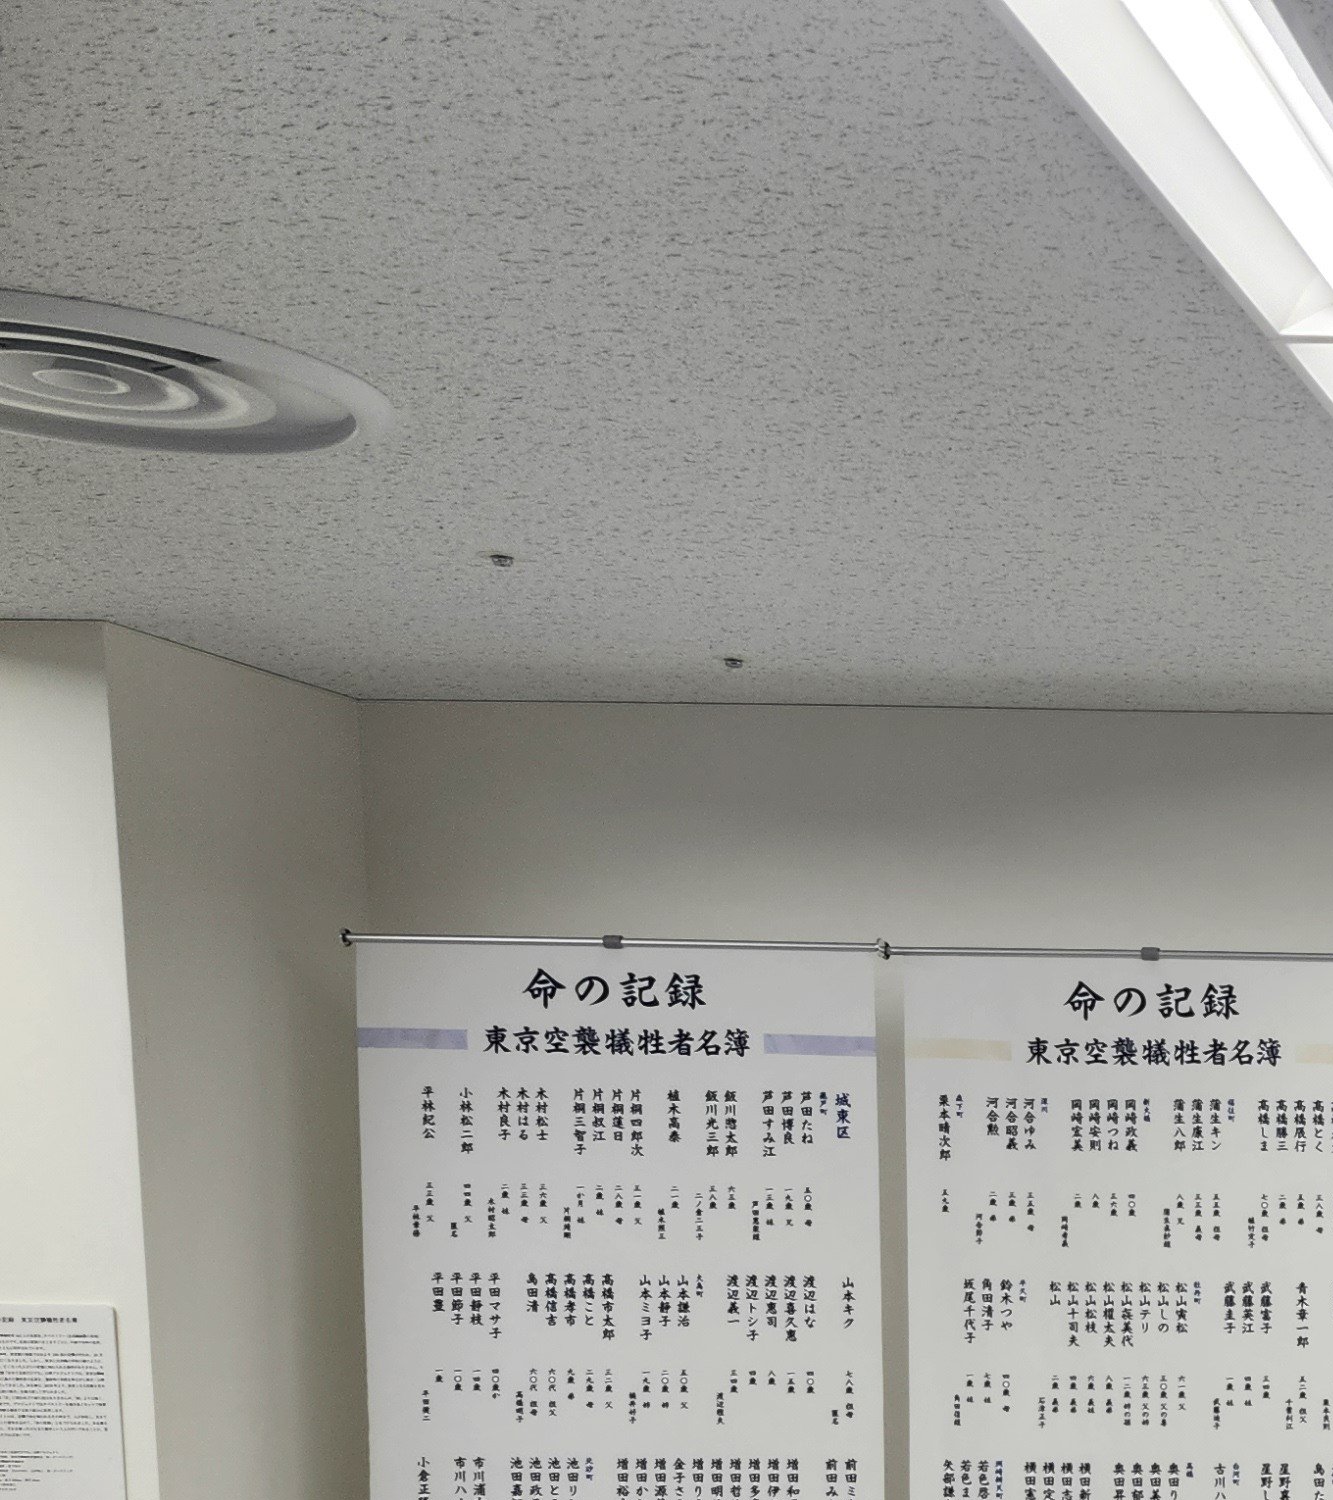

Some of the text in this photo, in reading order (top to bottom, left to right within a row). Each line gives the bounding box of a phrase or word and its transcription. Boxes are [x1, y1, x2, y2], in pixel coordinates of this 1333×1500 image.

[521, 967, 707, 1011] 命の記録
[1063, 980, 1240, 1022] 命の記録
[482, 1024, 751, 1058] 東京空襲犠牲者名簿
[1025, 1036, 1282, 1067] 東京空襲犠牲者名簿
[458, 1086, 474, 1155] 小林松二郎
[515, 1086, 531, 1141] 木村はる
[534, 1086, 550, 1141] 木村松士
[629, 1088, 645, 1157] 片桐四郎次
[761, 1089, 777, 1158] 芦田すみ江
[780, 1090, 796, 1145] 芦田博良
[799, 1090, 814, 1145] 芦田たね
[834, 1092, 852, 1140] 城東区
[487, 1272, 503, 1340] 平田マサ子
[638, 1274, 654, 1341] 山本ミヨ子
[745, 1273, 760, 1342] 渡辺トシ子
[841, 1276, 857, 1329] 山本キク
[981, 1277, 995, 1332] 角田清子
[999, 1278, 1014, 1332] 鈴木つや
[1138, 1280, 1152, 1334] 松山テリ
[1156, 1281, 1170, 1334] 松山しの
[1295, 1281, 1310, 1349] 青木章一郎
